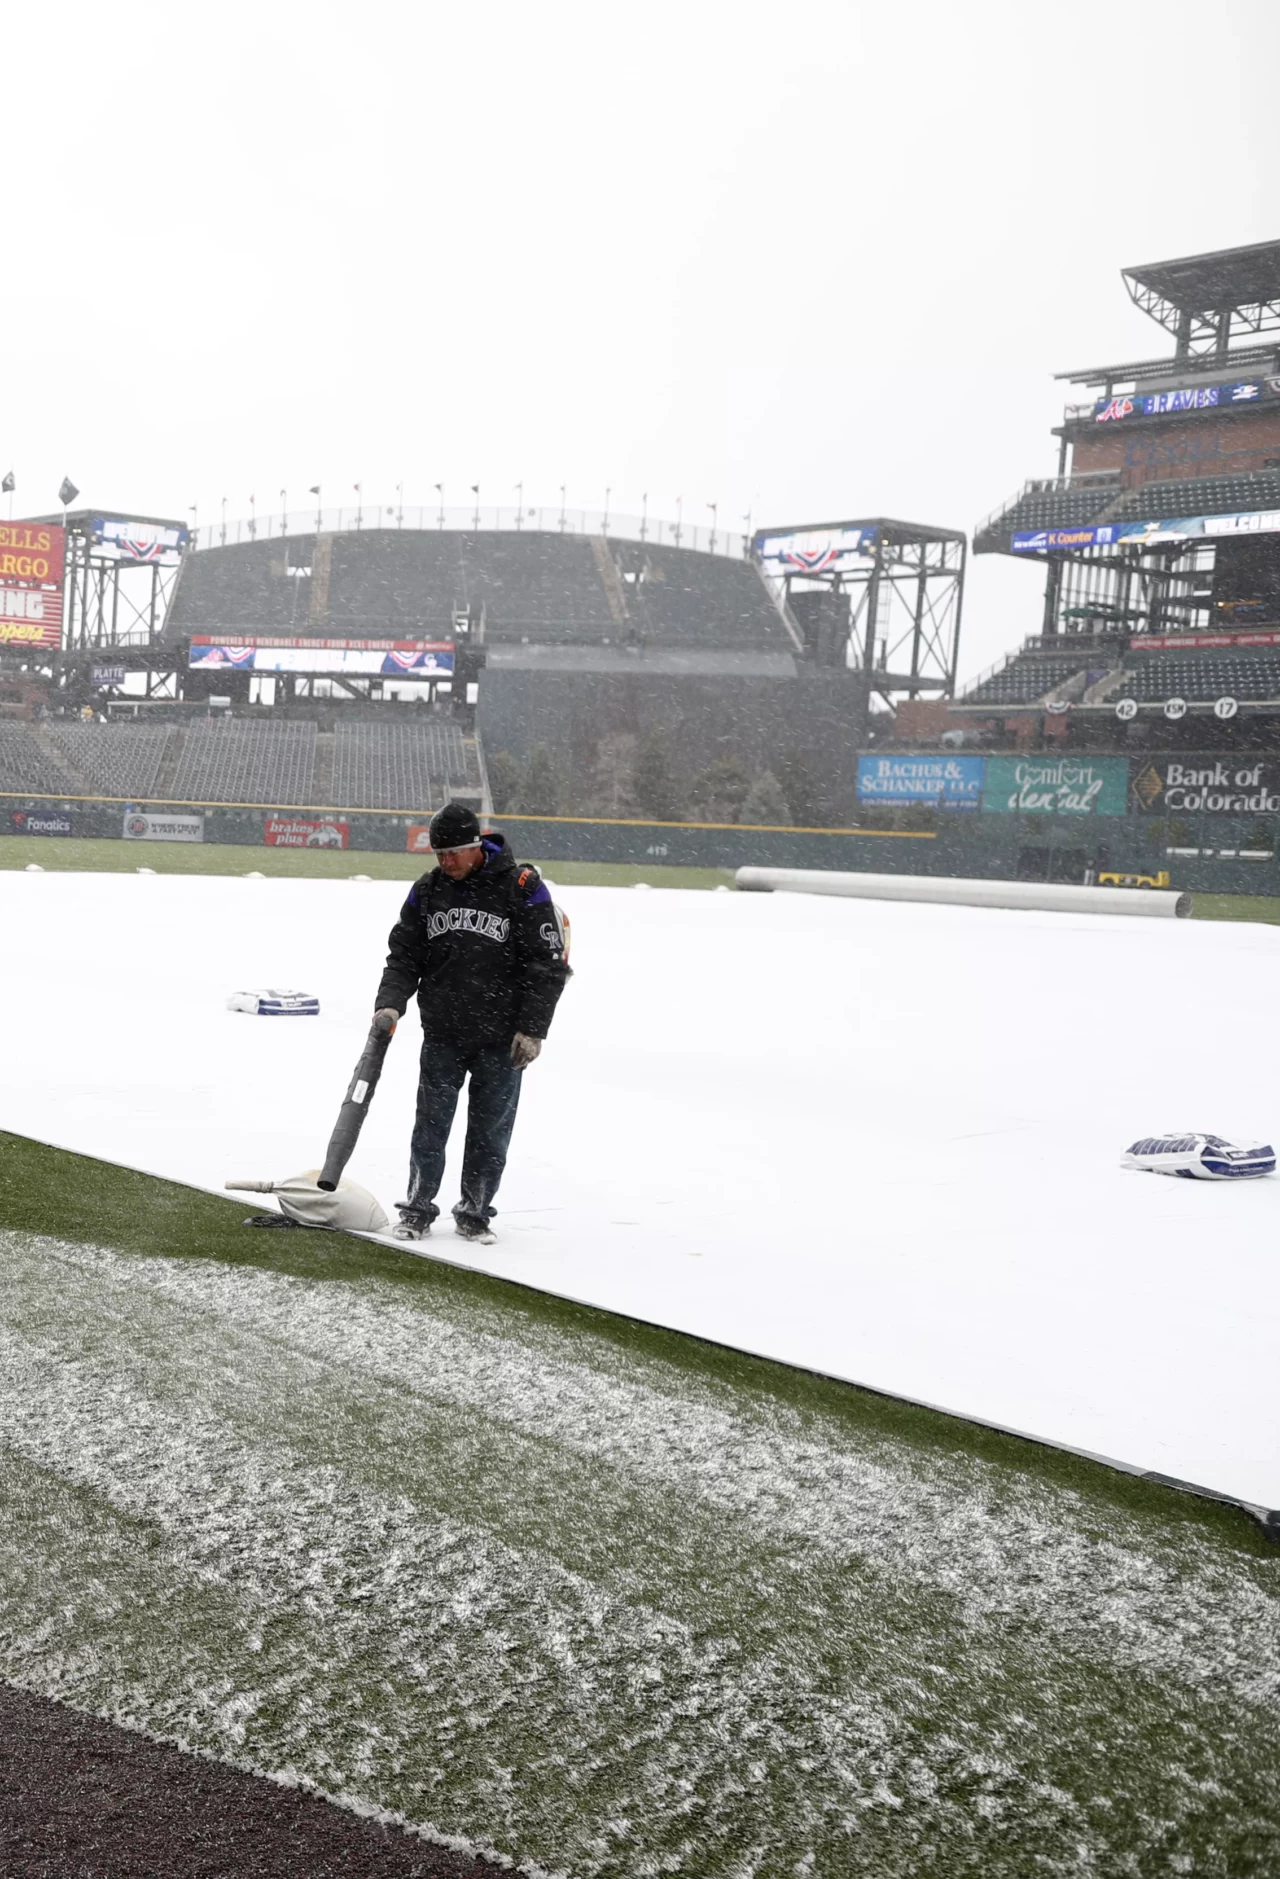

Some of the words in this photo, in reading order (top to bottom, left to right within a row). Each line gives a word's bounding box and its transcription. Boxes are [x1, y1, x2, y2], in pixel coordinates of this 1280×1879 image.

[1143, 387, 1220, 415] BRAVES
[1057, 531, 1094, 545] Counter
[210, 636, 244, 646] POWERED
[1118, 704, 1133, 717] 42
[1220, 703, 1234, 715] 17
[943, 760, 964, 779] &
[1166, 762, 1231, 787] Bank
[1234, 762, 1265, 787] of
[950, 780, 980, 792] LLC
[1164, 787, 1280, 812] Colorado
[27, 817, 70, 831] Fanatics
[270, 821, 315, 834] brakes
[276, 832, 303, 846] plus
[426, 907, 511, 943] ROCKIES
[539, 922, 564, 949] CR
